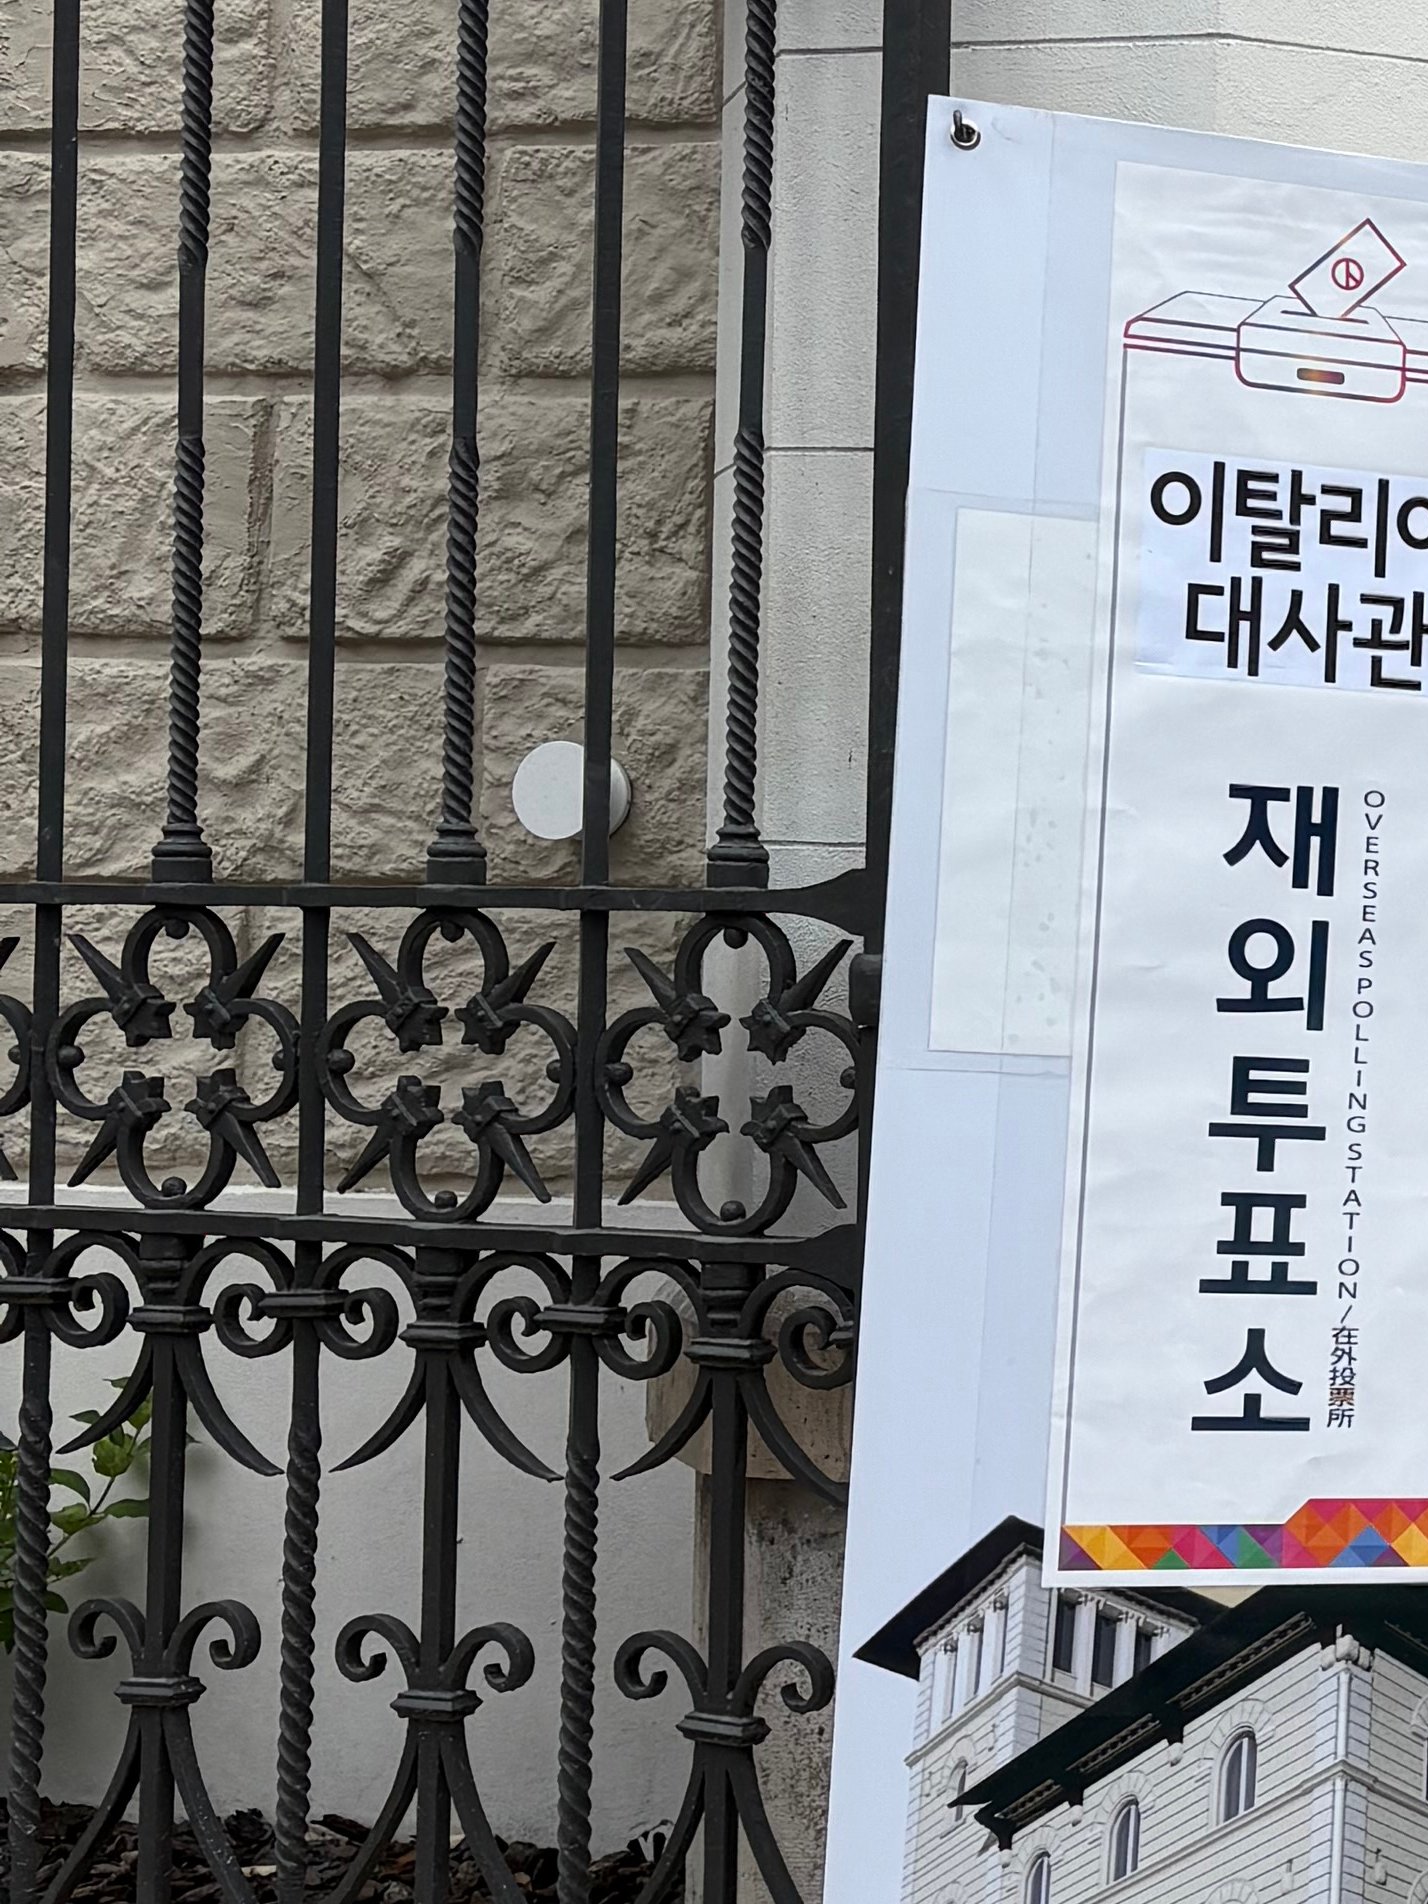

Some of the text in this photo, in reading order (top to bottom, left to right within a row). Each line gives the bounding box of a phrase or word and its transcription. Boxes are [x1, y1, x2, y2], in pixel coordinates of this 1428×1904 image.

[1357, 789, 1386, 969] OVERSEAS
[1190, 782, 1340, 1433] 재외투표소
[1346, 977, 1374, 1134] POLLING
